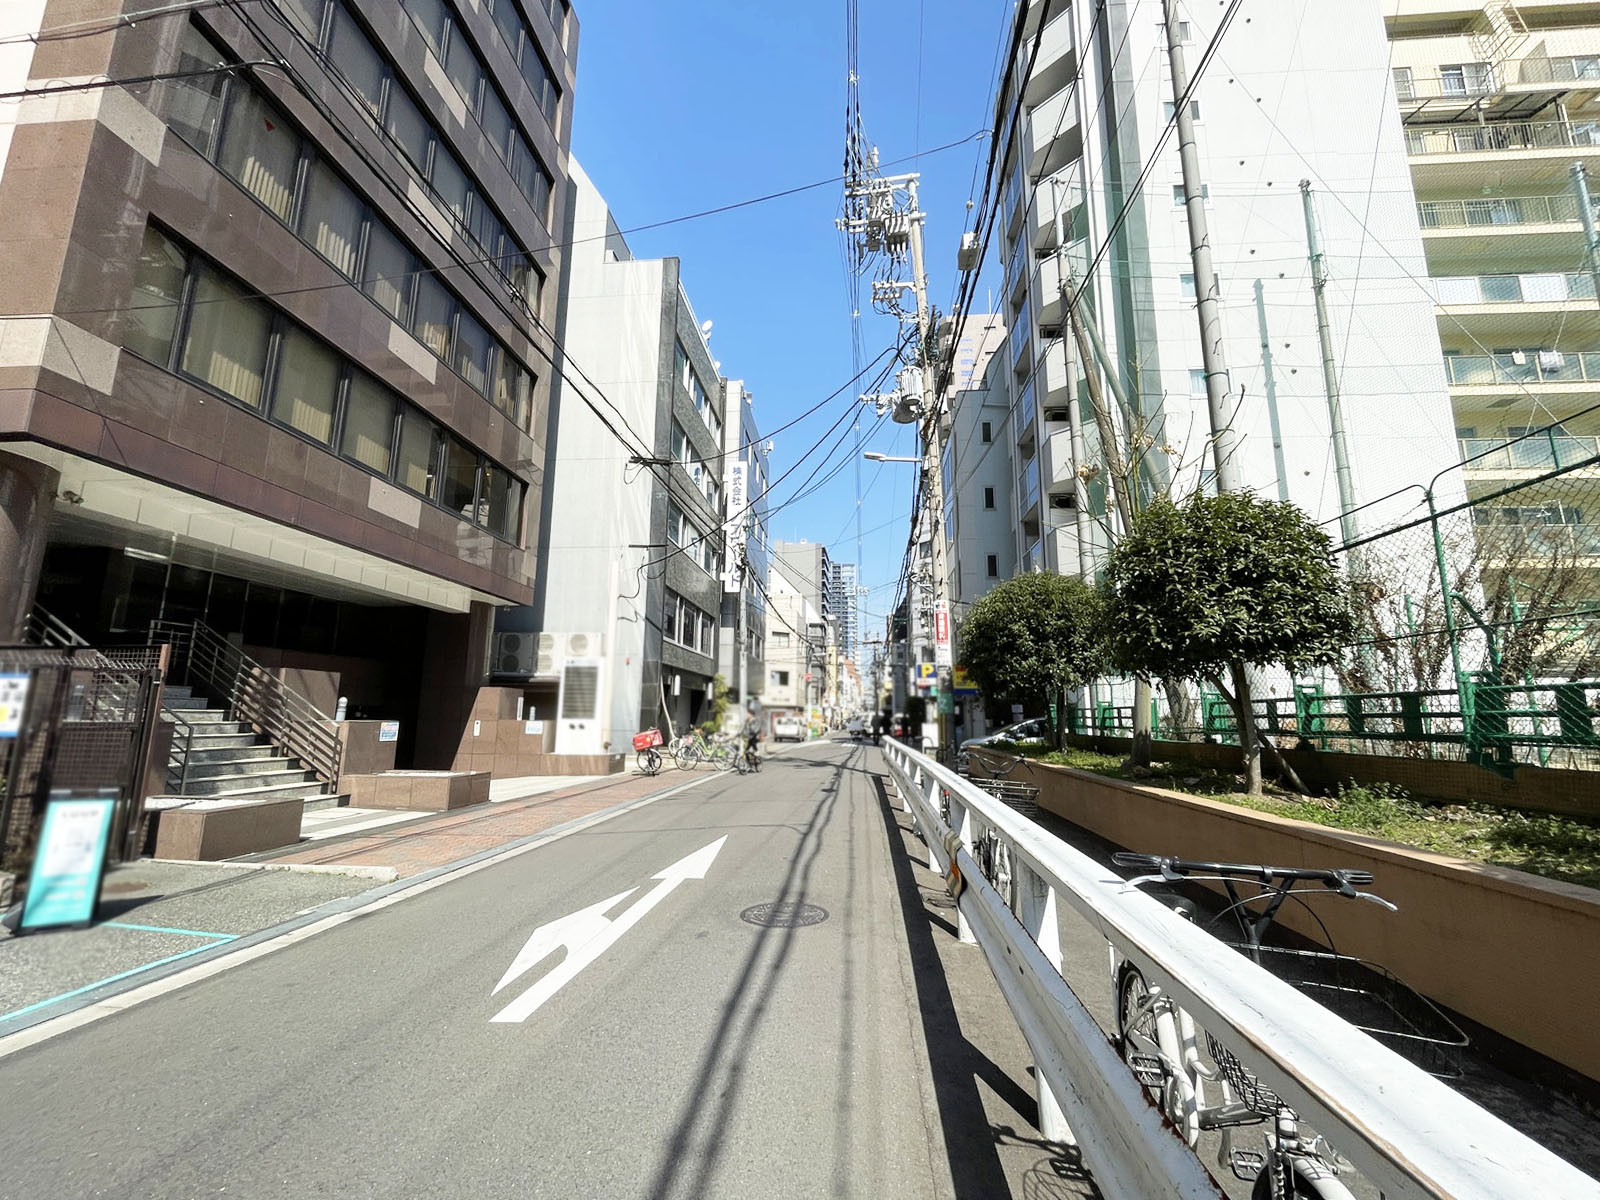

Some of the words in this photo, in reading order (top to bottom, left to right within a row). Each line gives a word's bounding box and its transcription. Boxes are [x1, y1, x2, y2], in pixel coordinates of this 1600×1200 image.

[731, 466, 743, 506] 株式会社
[921, 663, 935, 679] P
